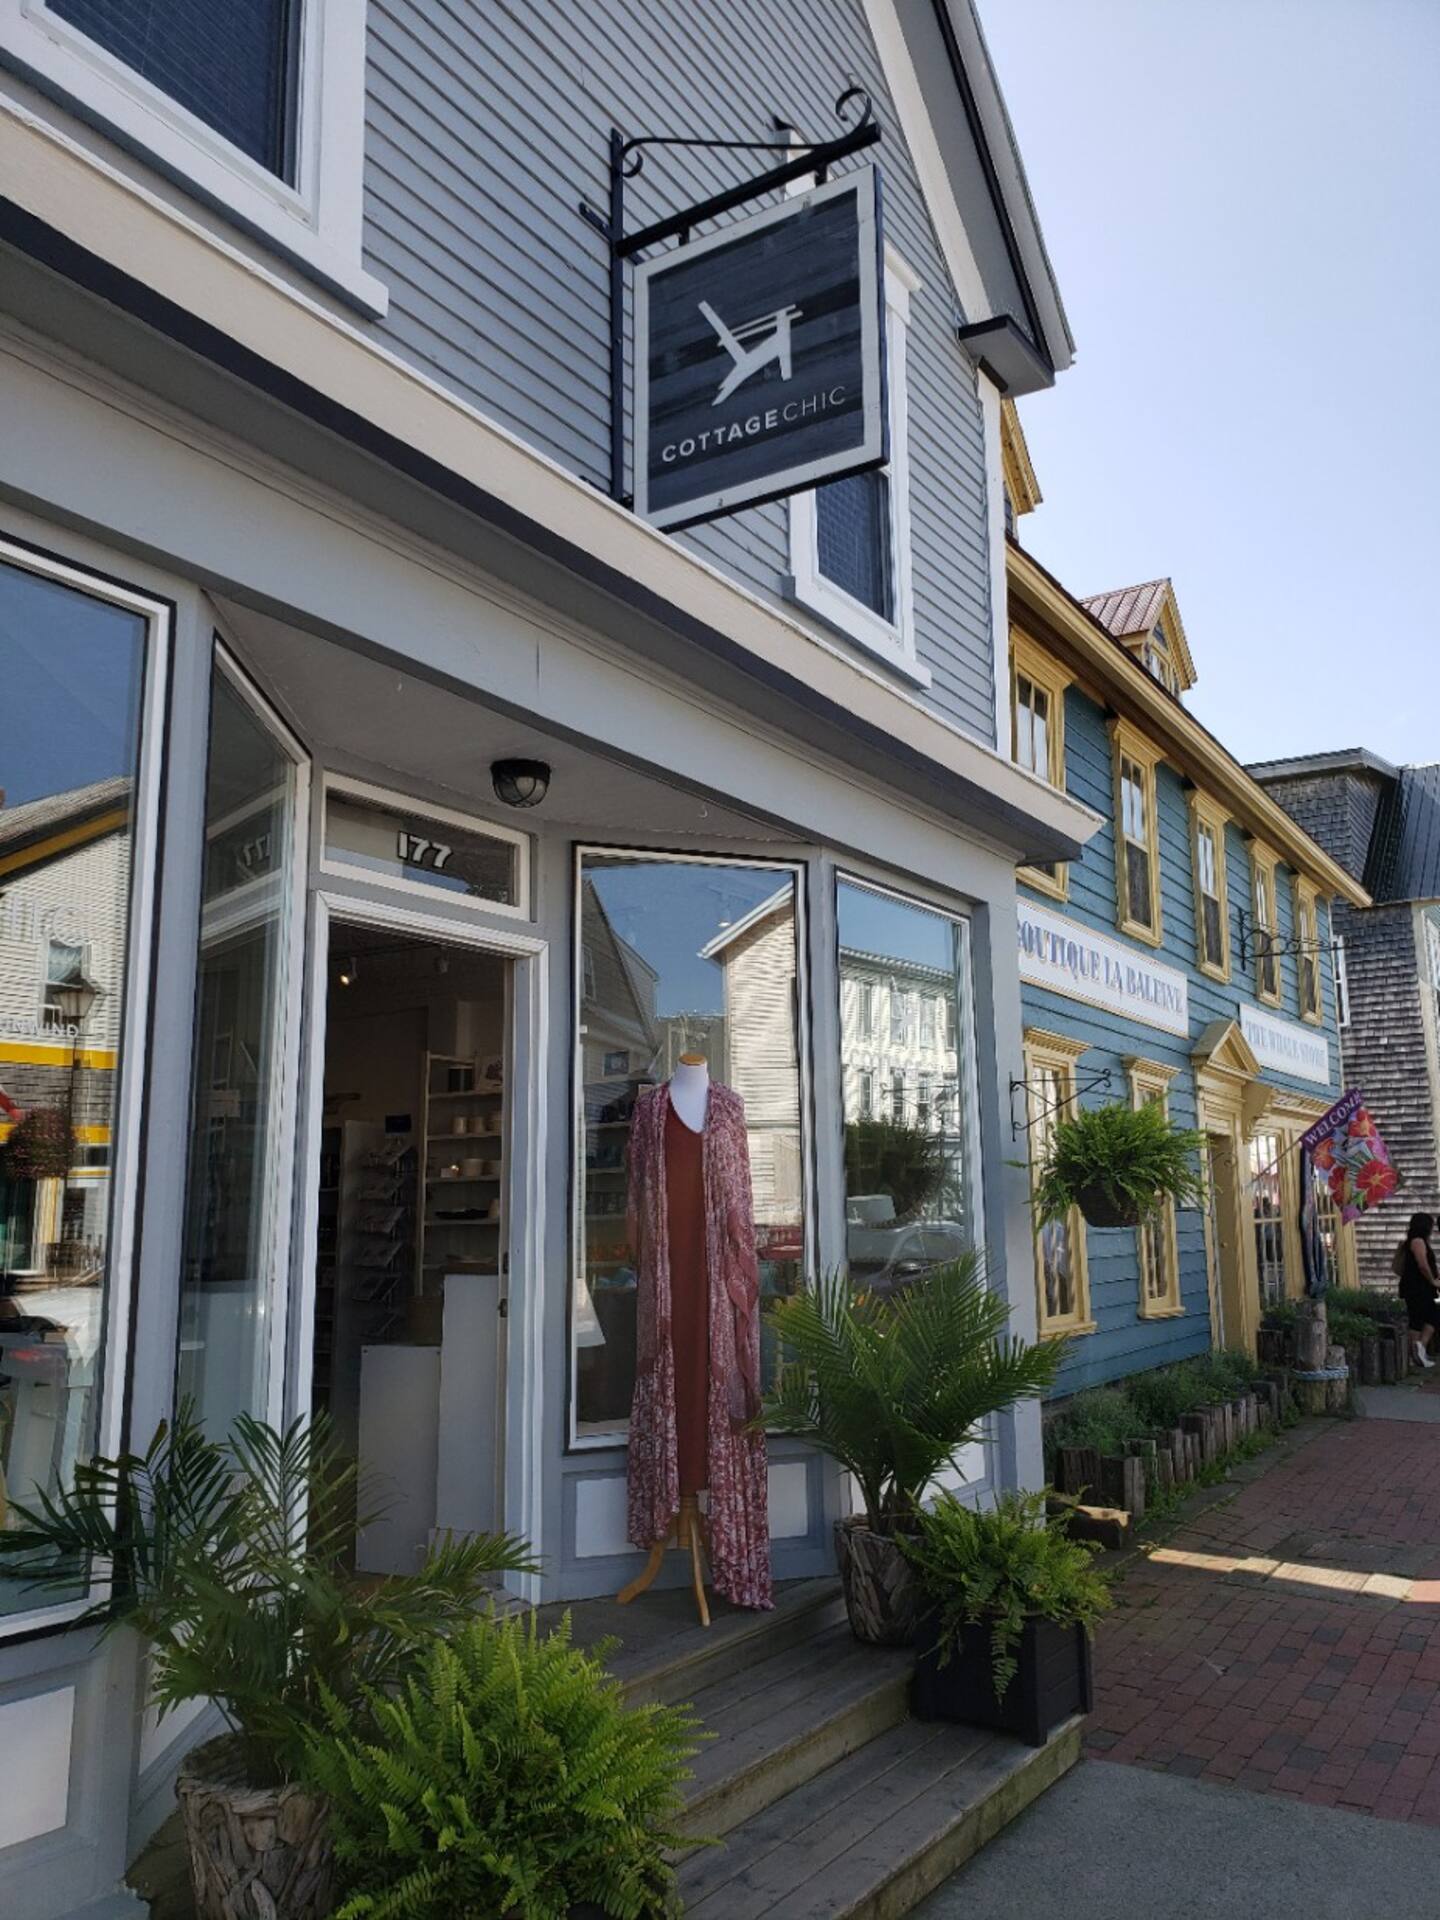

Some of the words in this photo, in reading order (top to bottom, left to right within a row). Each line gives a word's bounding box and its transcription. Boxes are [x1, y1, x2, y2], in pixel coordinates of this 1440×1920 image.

[398, 831, 453, 868] 177
[1104, 955, 1123, 992] LA
[1126, 965, 1184, 1015] BALEINE
